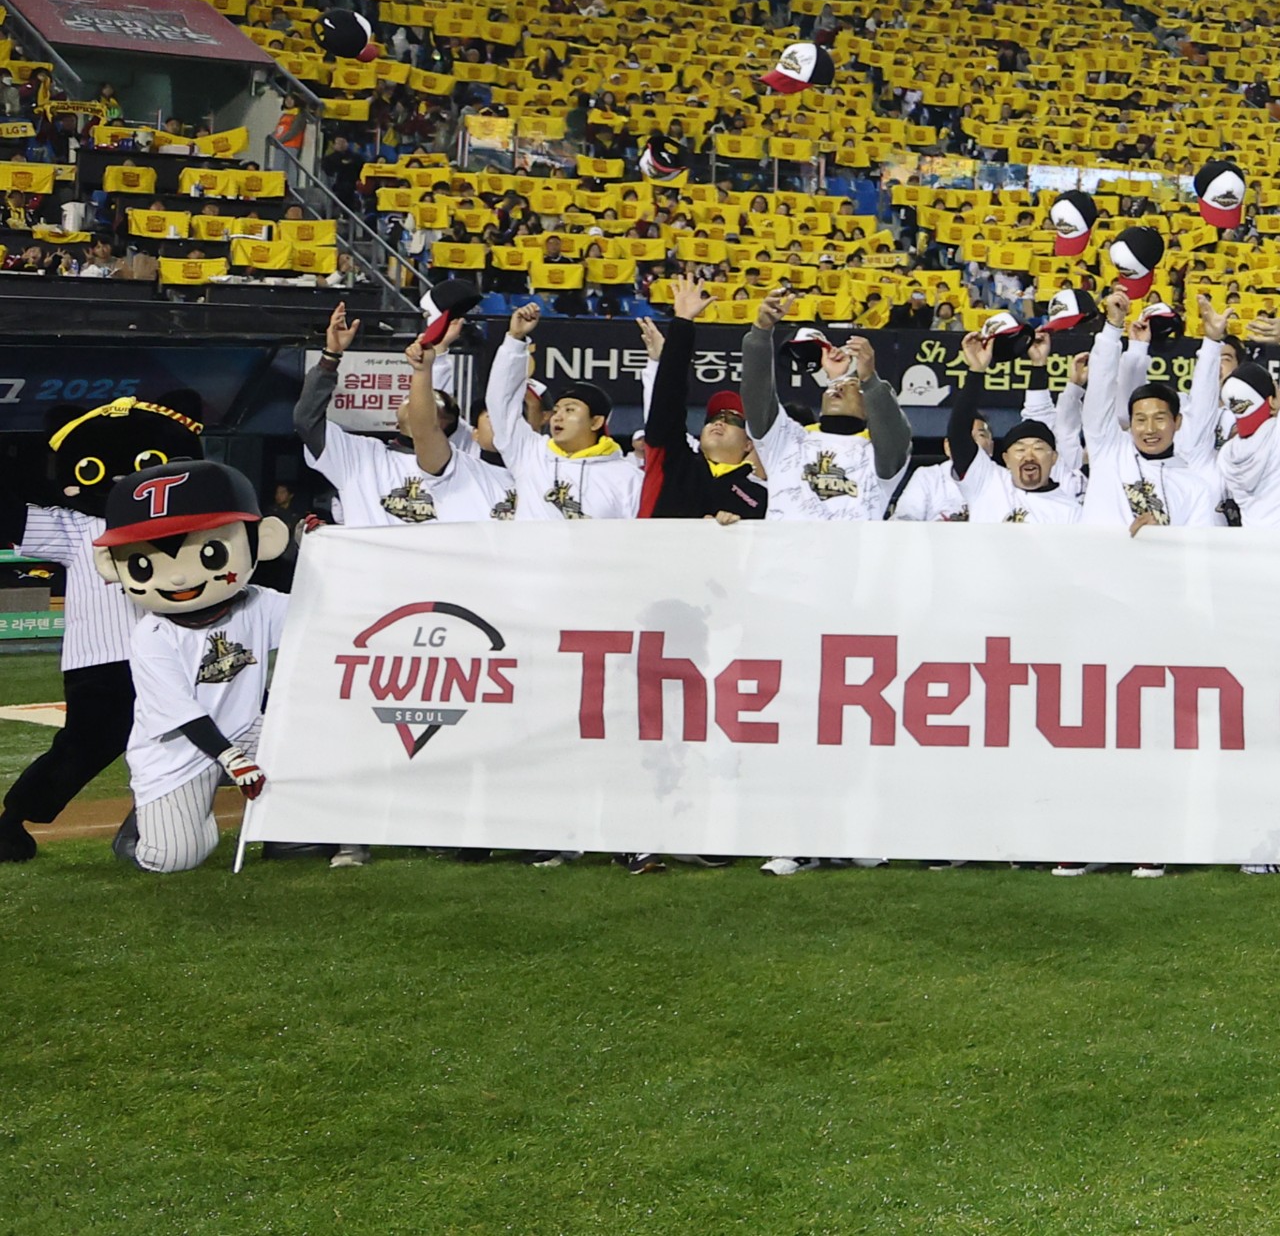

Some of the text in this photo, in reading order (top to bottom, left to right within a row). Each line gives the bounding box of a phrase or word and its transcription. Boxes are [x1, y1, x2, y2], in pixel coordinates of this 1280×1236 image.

[915, 339, 947, 363] Sh
[545, 347, 743, 383] NH투증
[36, 379, 140, 400] 2025
[344, 373, 393, 390] 승리를
[335, 394, 383, 410] 하나의
[133, 471, 190, 518] T
[12, 618, 50, 631] 라쿠텐
[413, 626, 447, 647] LG
[335, 655, 517, 703] TWINS
[560, 630, 781, 743] The
[816, 635, 1244, 749] Return
[396, 710, 443, 722] SEOUL
